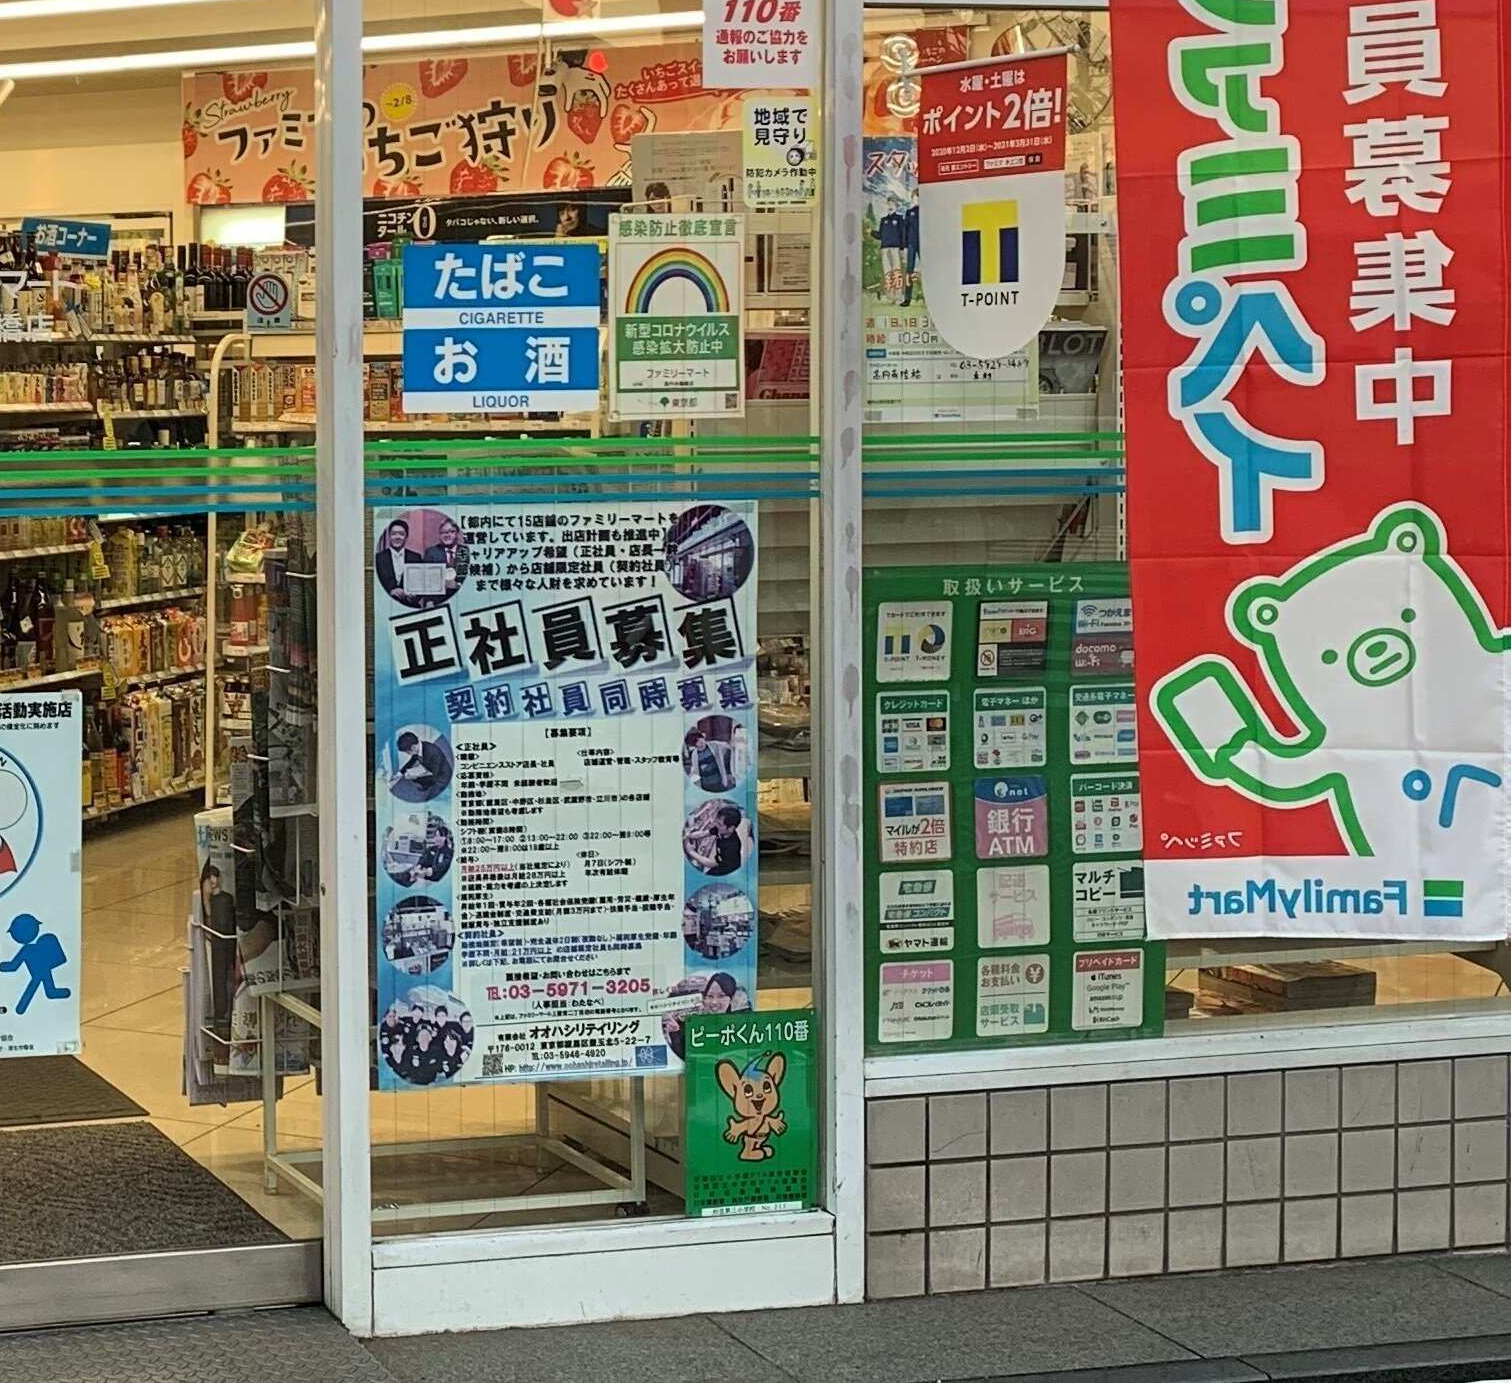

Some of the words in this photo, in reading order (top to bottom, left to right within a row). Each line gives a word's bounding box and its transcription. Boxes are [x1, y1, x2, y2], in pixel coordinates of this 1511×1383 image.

[716, 29, 809, 45] 通報のご協力を
[723, 49, 802, 65] お願いします
[959, 69, 1026, 93] 水曜・土曜は
[203, 86, 295, 130] Strawberry
[754, 107, 808, 125] 地域で
[922, 87, 1062, 135] ポイント2倍!
[754, 127, 806, 146] 見守り
[746, 167, 816, 178] 防犯カメラ作動中
[377, 212, 414, 225] ニコチン
[35, 223, 97, 248] お酒コーナー
[618, 220, 736, 237] 感染防止徹底宣言
[434, 251, 569, 300] たばこ
[961, 291, 1020, 307] T-POINT
[459, 311, 545, 325] CIGARETTE
[625, 323, 730, 338] 新型コロナウイルス
[632, 339, 723, 355] 感染拡大防止中
[646, 369, 711, 379] ファミリーマート
[472, 395, 530, 408] LIQUOR
[942, 576, 1085, 596] 取扱いサービス
[393, 602, 741, 679] 正社員募集
[1075, 643, 1117, 655] docomo
[445, 678, 751, 720] 契約社員同時募集
[883, 698, 944, 710] クレジットカード
[1078, 781, 1133, 792] バーコード決済
[885, 818, 945, 836] マイルが2倍
[987, 807, 1035, 834] 銀行
[894, 839, 937, 856] 特約店
[988, 836, 1034, 856] ATM
[1075, 869, 1116, 884] マルチ
[1075, 887, 1116, 901] コピー
[1078, 955, 1137, 969] プリペイドカード
[900, 969, 933, 979] チケット
[980, 975, 1021, 987] お支払い
[1097, 972, 1122, 981] iTunes
[1087, 983, 1110, 993] Google
[529, 1020, 641, 1039] オオハシリテイリング
[980, 1016, 1021, 1027] サービス
[691, 1019, 809, 1048] ピーポくん110番
